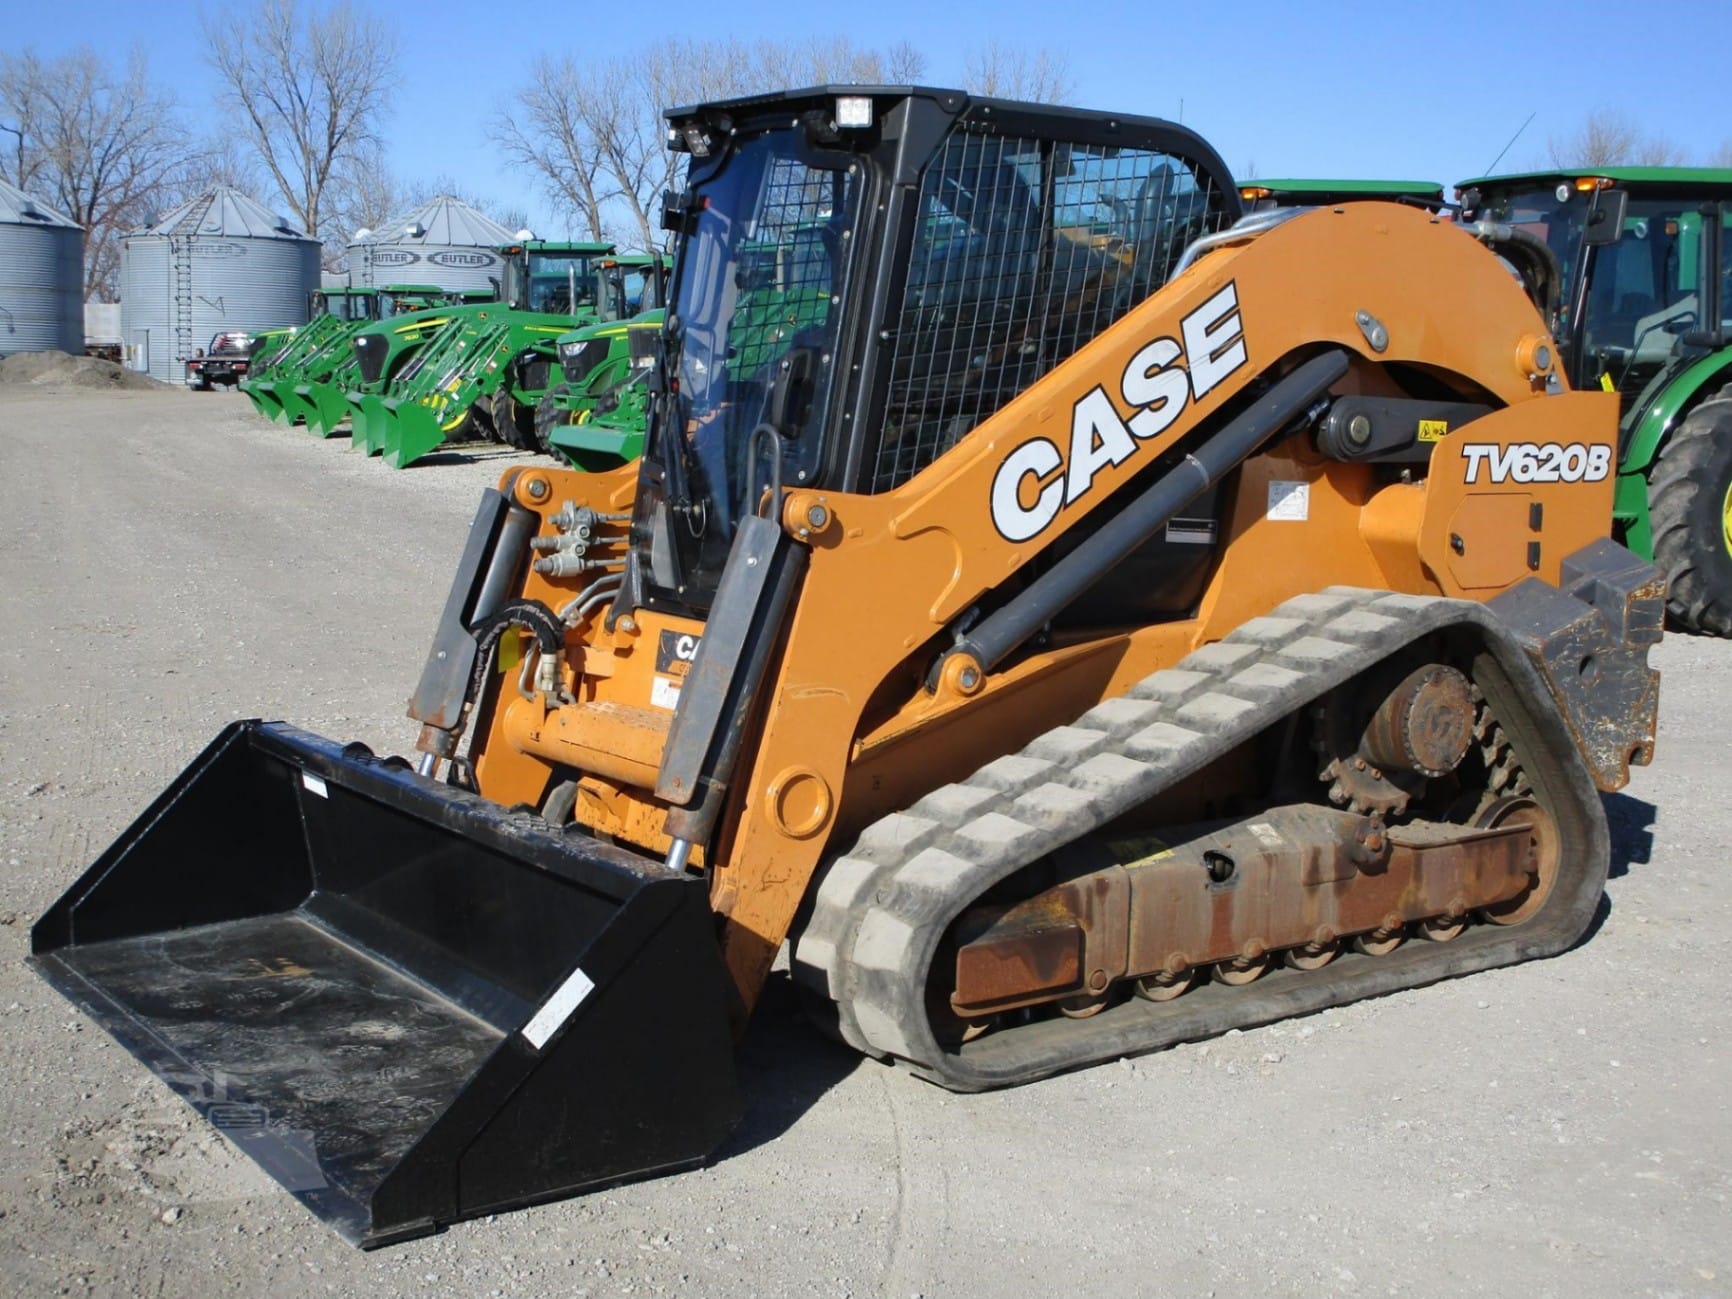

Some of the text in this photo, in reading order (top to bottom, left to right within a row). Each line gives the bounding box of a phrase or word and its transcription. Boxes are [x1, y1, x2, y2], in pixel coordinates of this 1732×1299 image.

[441, 255, 484, 265] BUTLER
[990, 278, 1249, 544] CASE
[1461, 442, 1613, 484] TV620B
